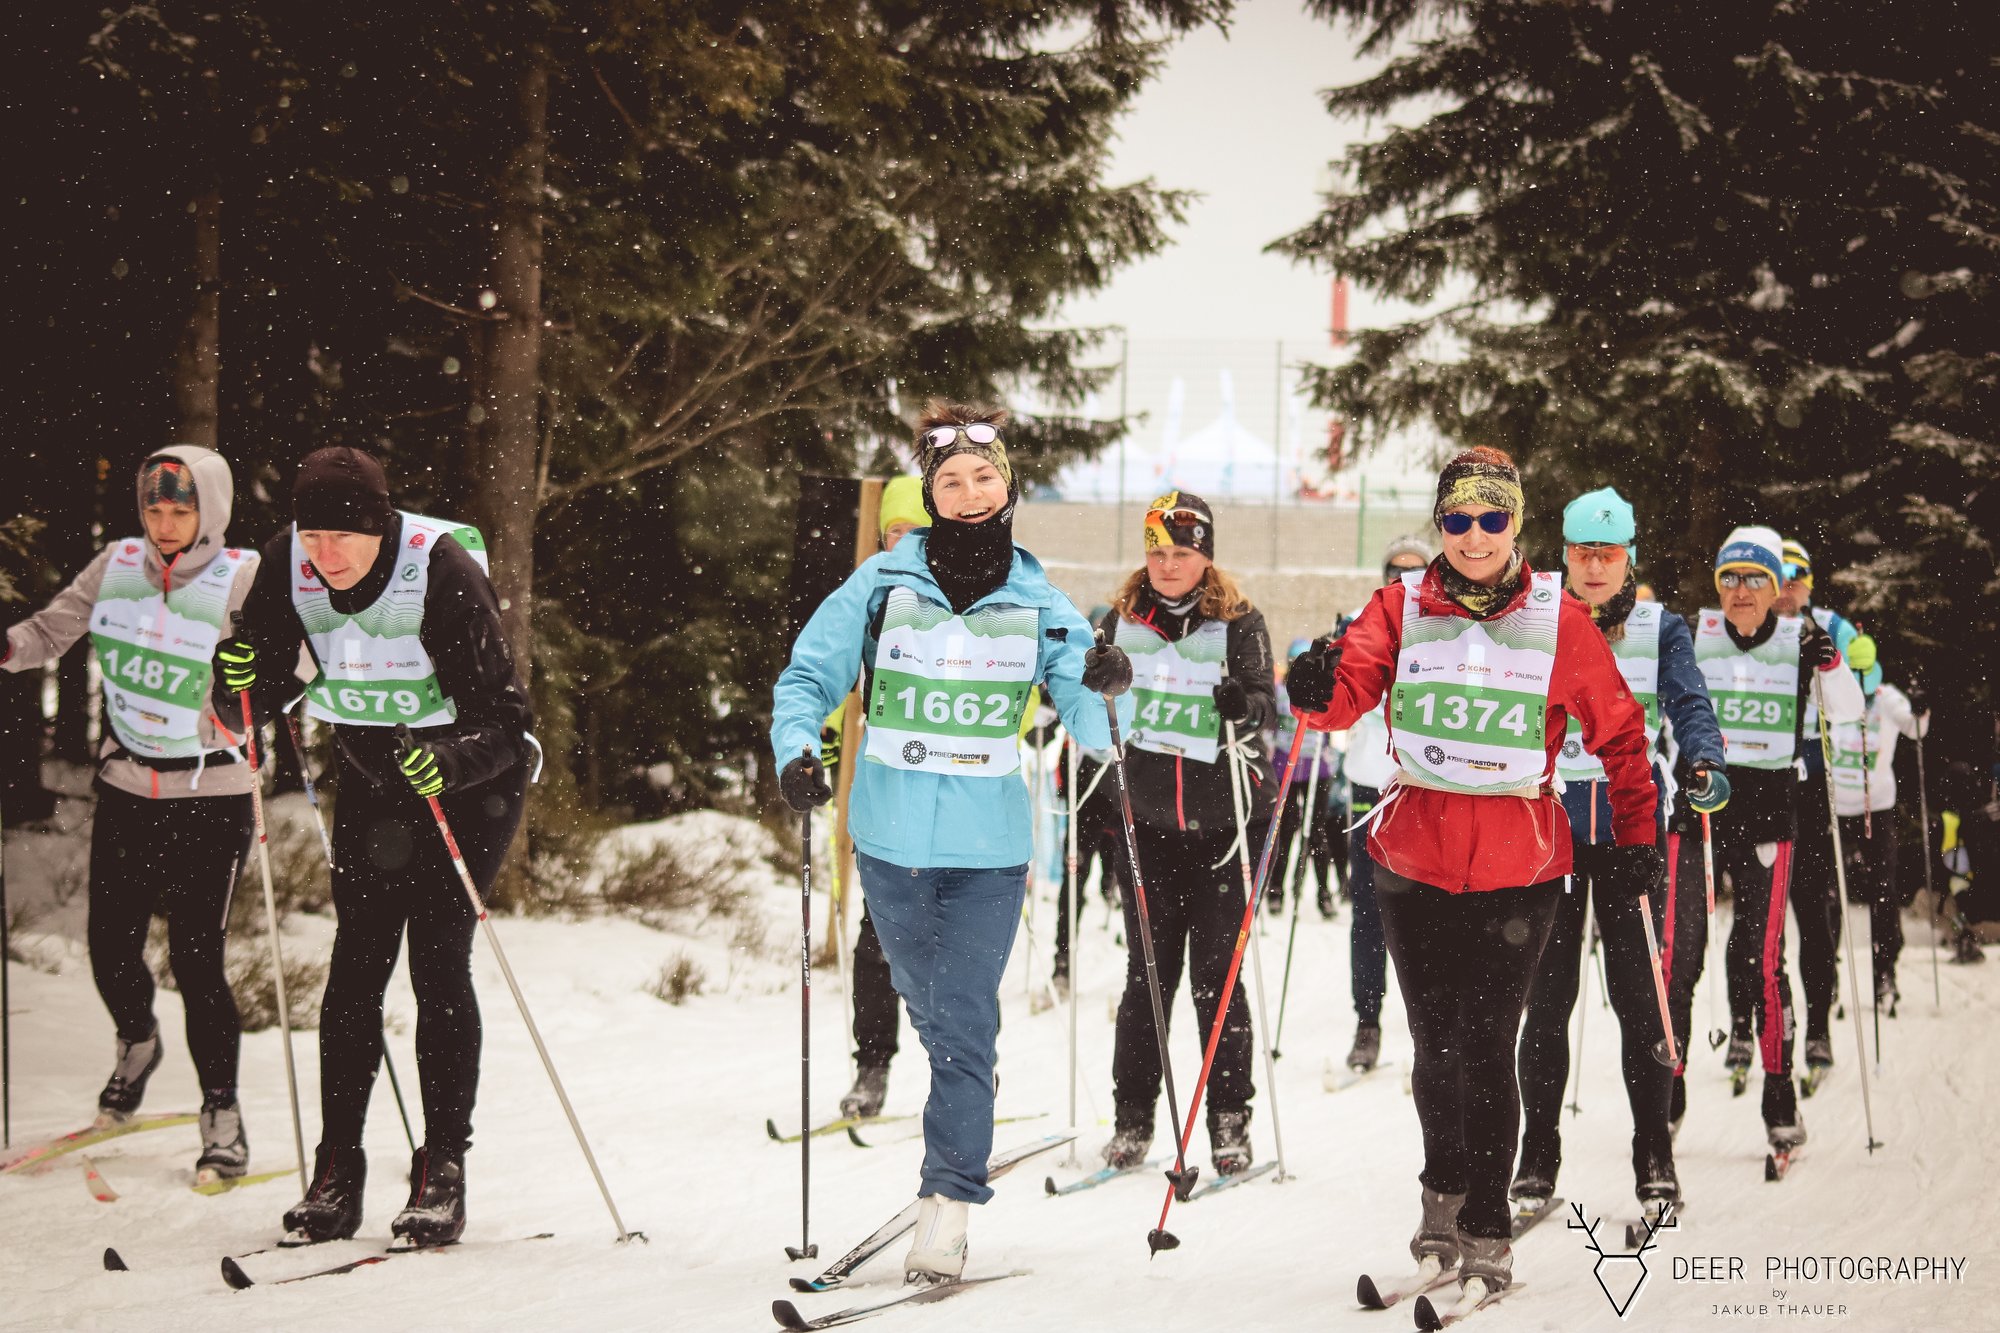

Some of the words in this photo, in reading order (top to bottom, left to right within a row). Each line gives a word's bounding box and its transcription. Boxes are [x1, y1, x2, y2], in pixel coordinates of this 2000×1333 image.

[105, 649, 190, 695] 1487
[997, 660, 1026, 668] TAURON
[1467, 665, 1491, 673] KGHM
[879, 680, 887, 691] CT
[1515, 672, 1543, 682] TAURON
[316, 687, 421, 715] 1679
[897, 686, 1010, 727] 1662
[1415, 693, 1528, 737] 1374
